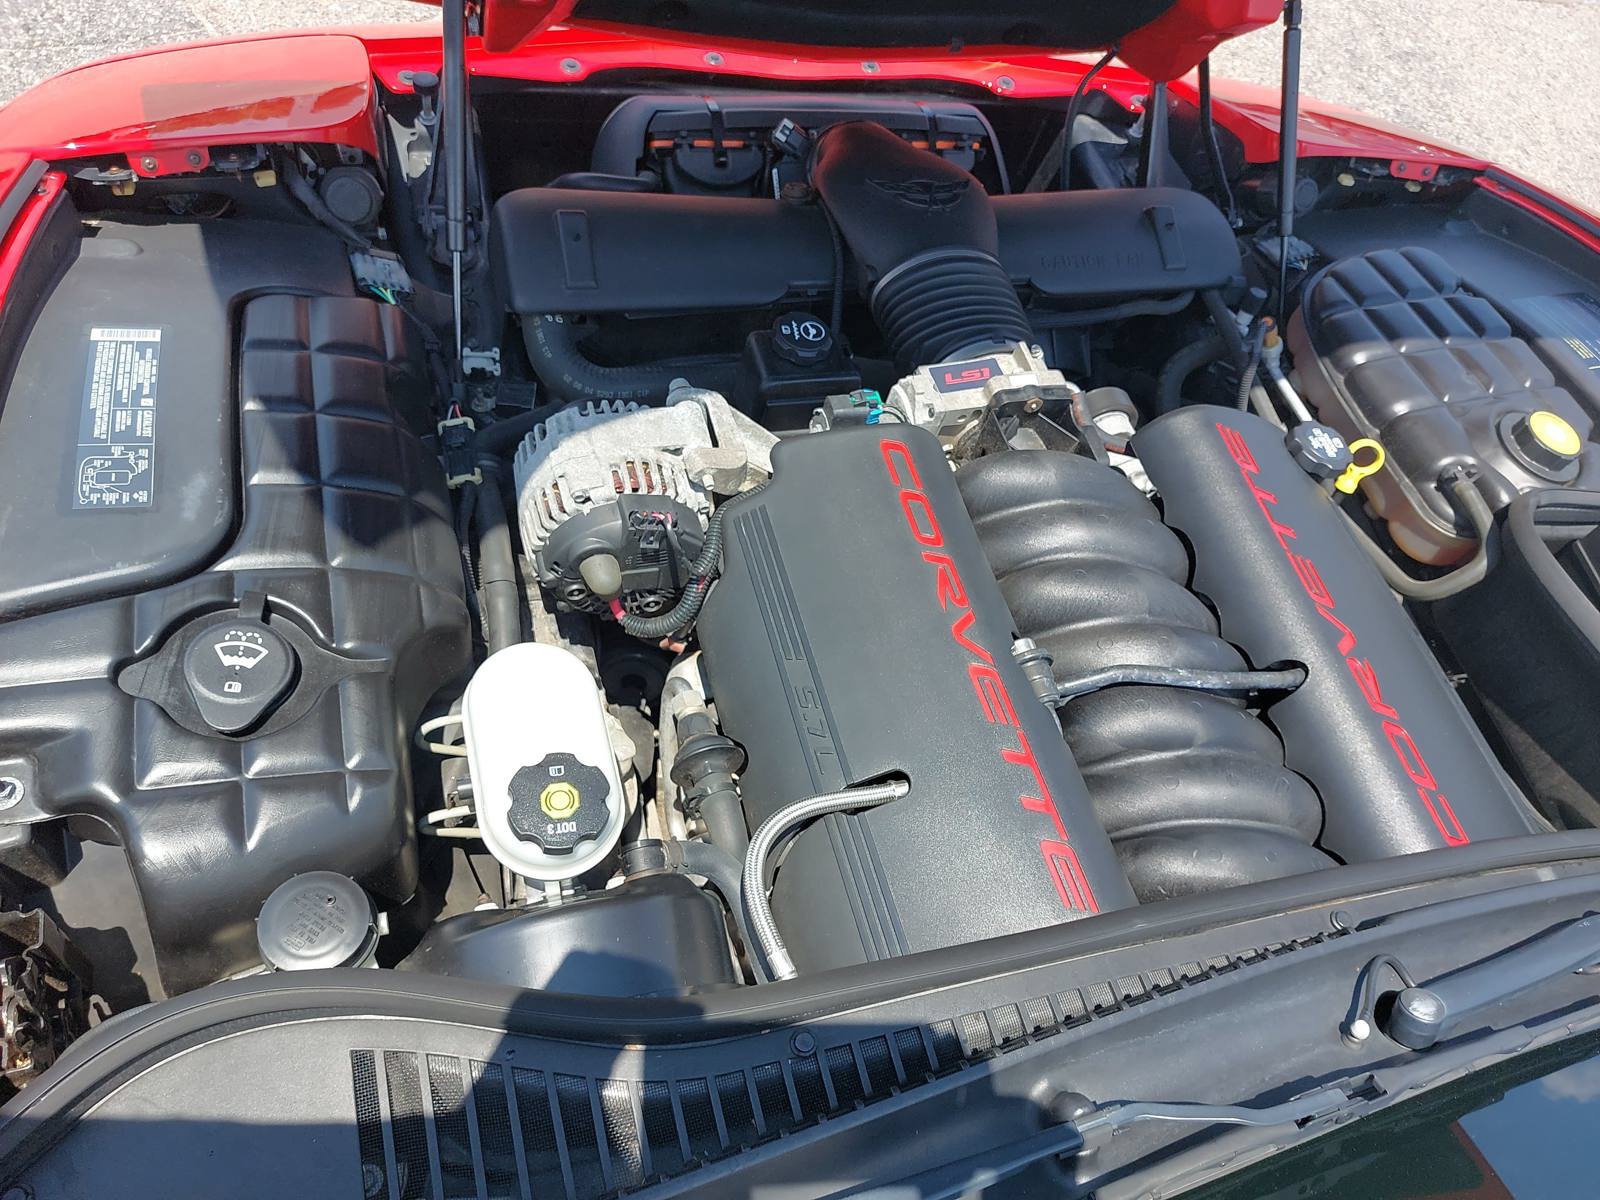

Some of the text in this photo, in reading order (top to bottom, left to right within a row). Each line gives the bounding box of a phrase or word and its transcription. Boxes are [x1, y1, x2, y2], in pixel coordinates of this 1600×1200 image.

[944, 367, 990, 385] LS1
[142, 410, 153, 438] CATALYST
[1216, 423, 1470, 847] CORVETTE
[880, 439, 1099, 913] CORVETTE
[546, 821, 577, 835] DOT 3
